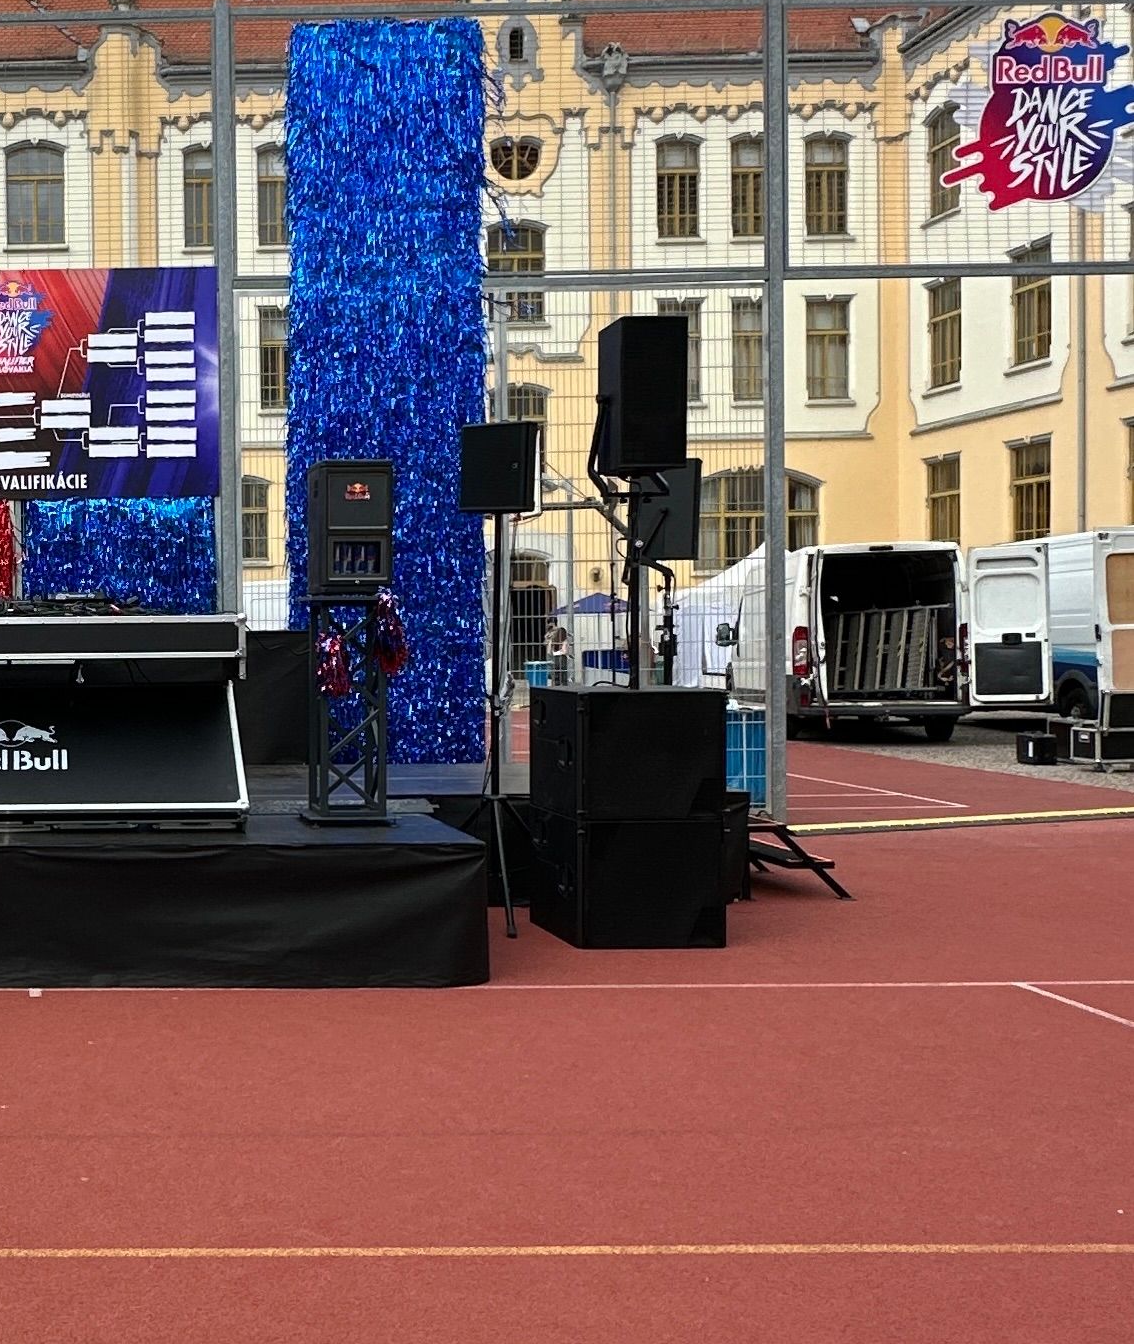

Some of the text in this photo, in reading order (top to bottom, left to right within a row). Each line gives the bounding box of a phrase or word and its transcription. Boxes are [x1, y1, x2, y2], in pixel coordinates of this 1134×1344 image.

[996, 54, 1105, 84] Red Bull
[1006, 85, 1096, 127] DANCE
[1014, 112, 1101, 156] YOUR
[1007, 137, 1095, 195] STYLE
[13, 297, 37, 310] Bull
[0, 322, 36, 341] YOUR
[13, 749, 69, 771] Bull
